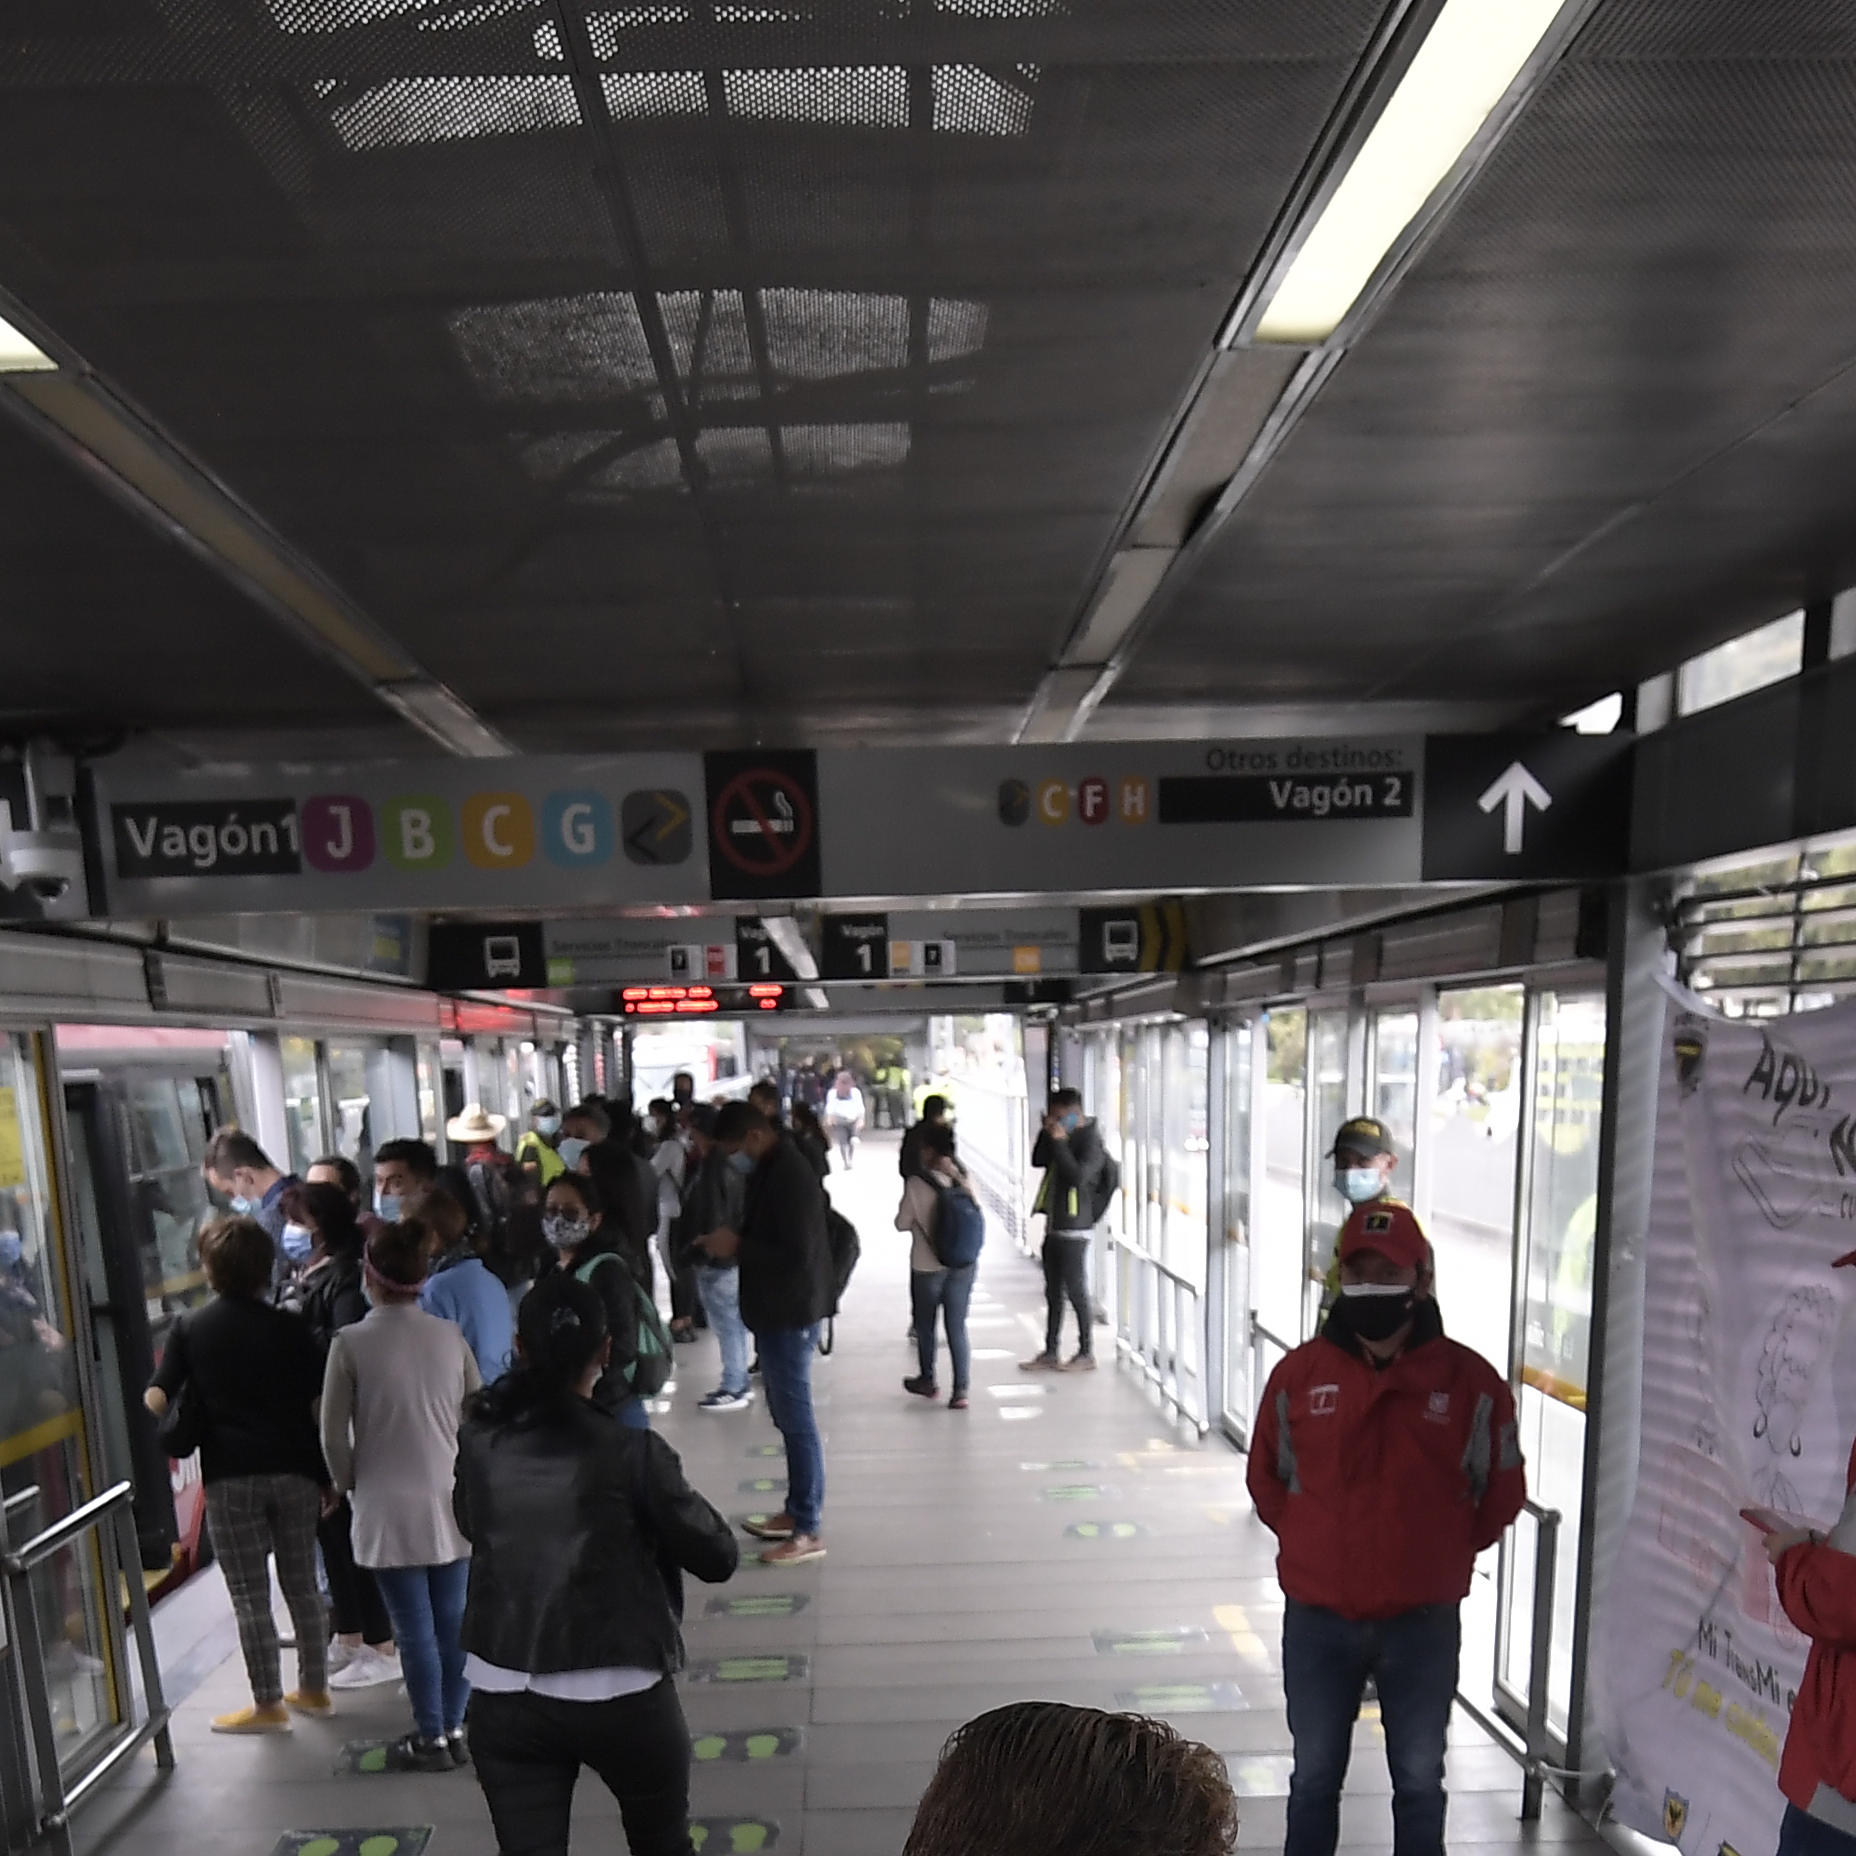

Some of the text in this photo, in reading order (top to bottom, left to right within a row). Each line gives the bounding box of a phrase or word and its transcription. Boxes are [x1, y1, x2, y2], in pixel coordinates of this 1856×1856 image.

[1206, 744, 1404, 771] Otros destinos:
[1044, 783, 1144, 817] C F H
[1270, 778, 1402, 816] Vagón 2
[327, 804, 354, 858] J
[401, 807, 436, 860] B
[482, 804, 513, 857] C
[561, 802, 596, 854] G
[754, 946, 771, 974] 1
[856, 943, 872, 972] 1
